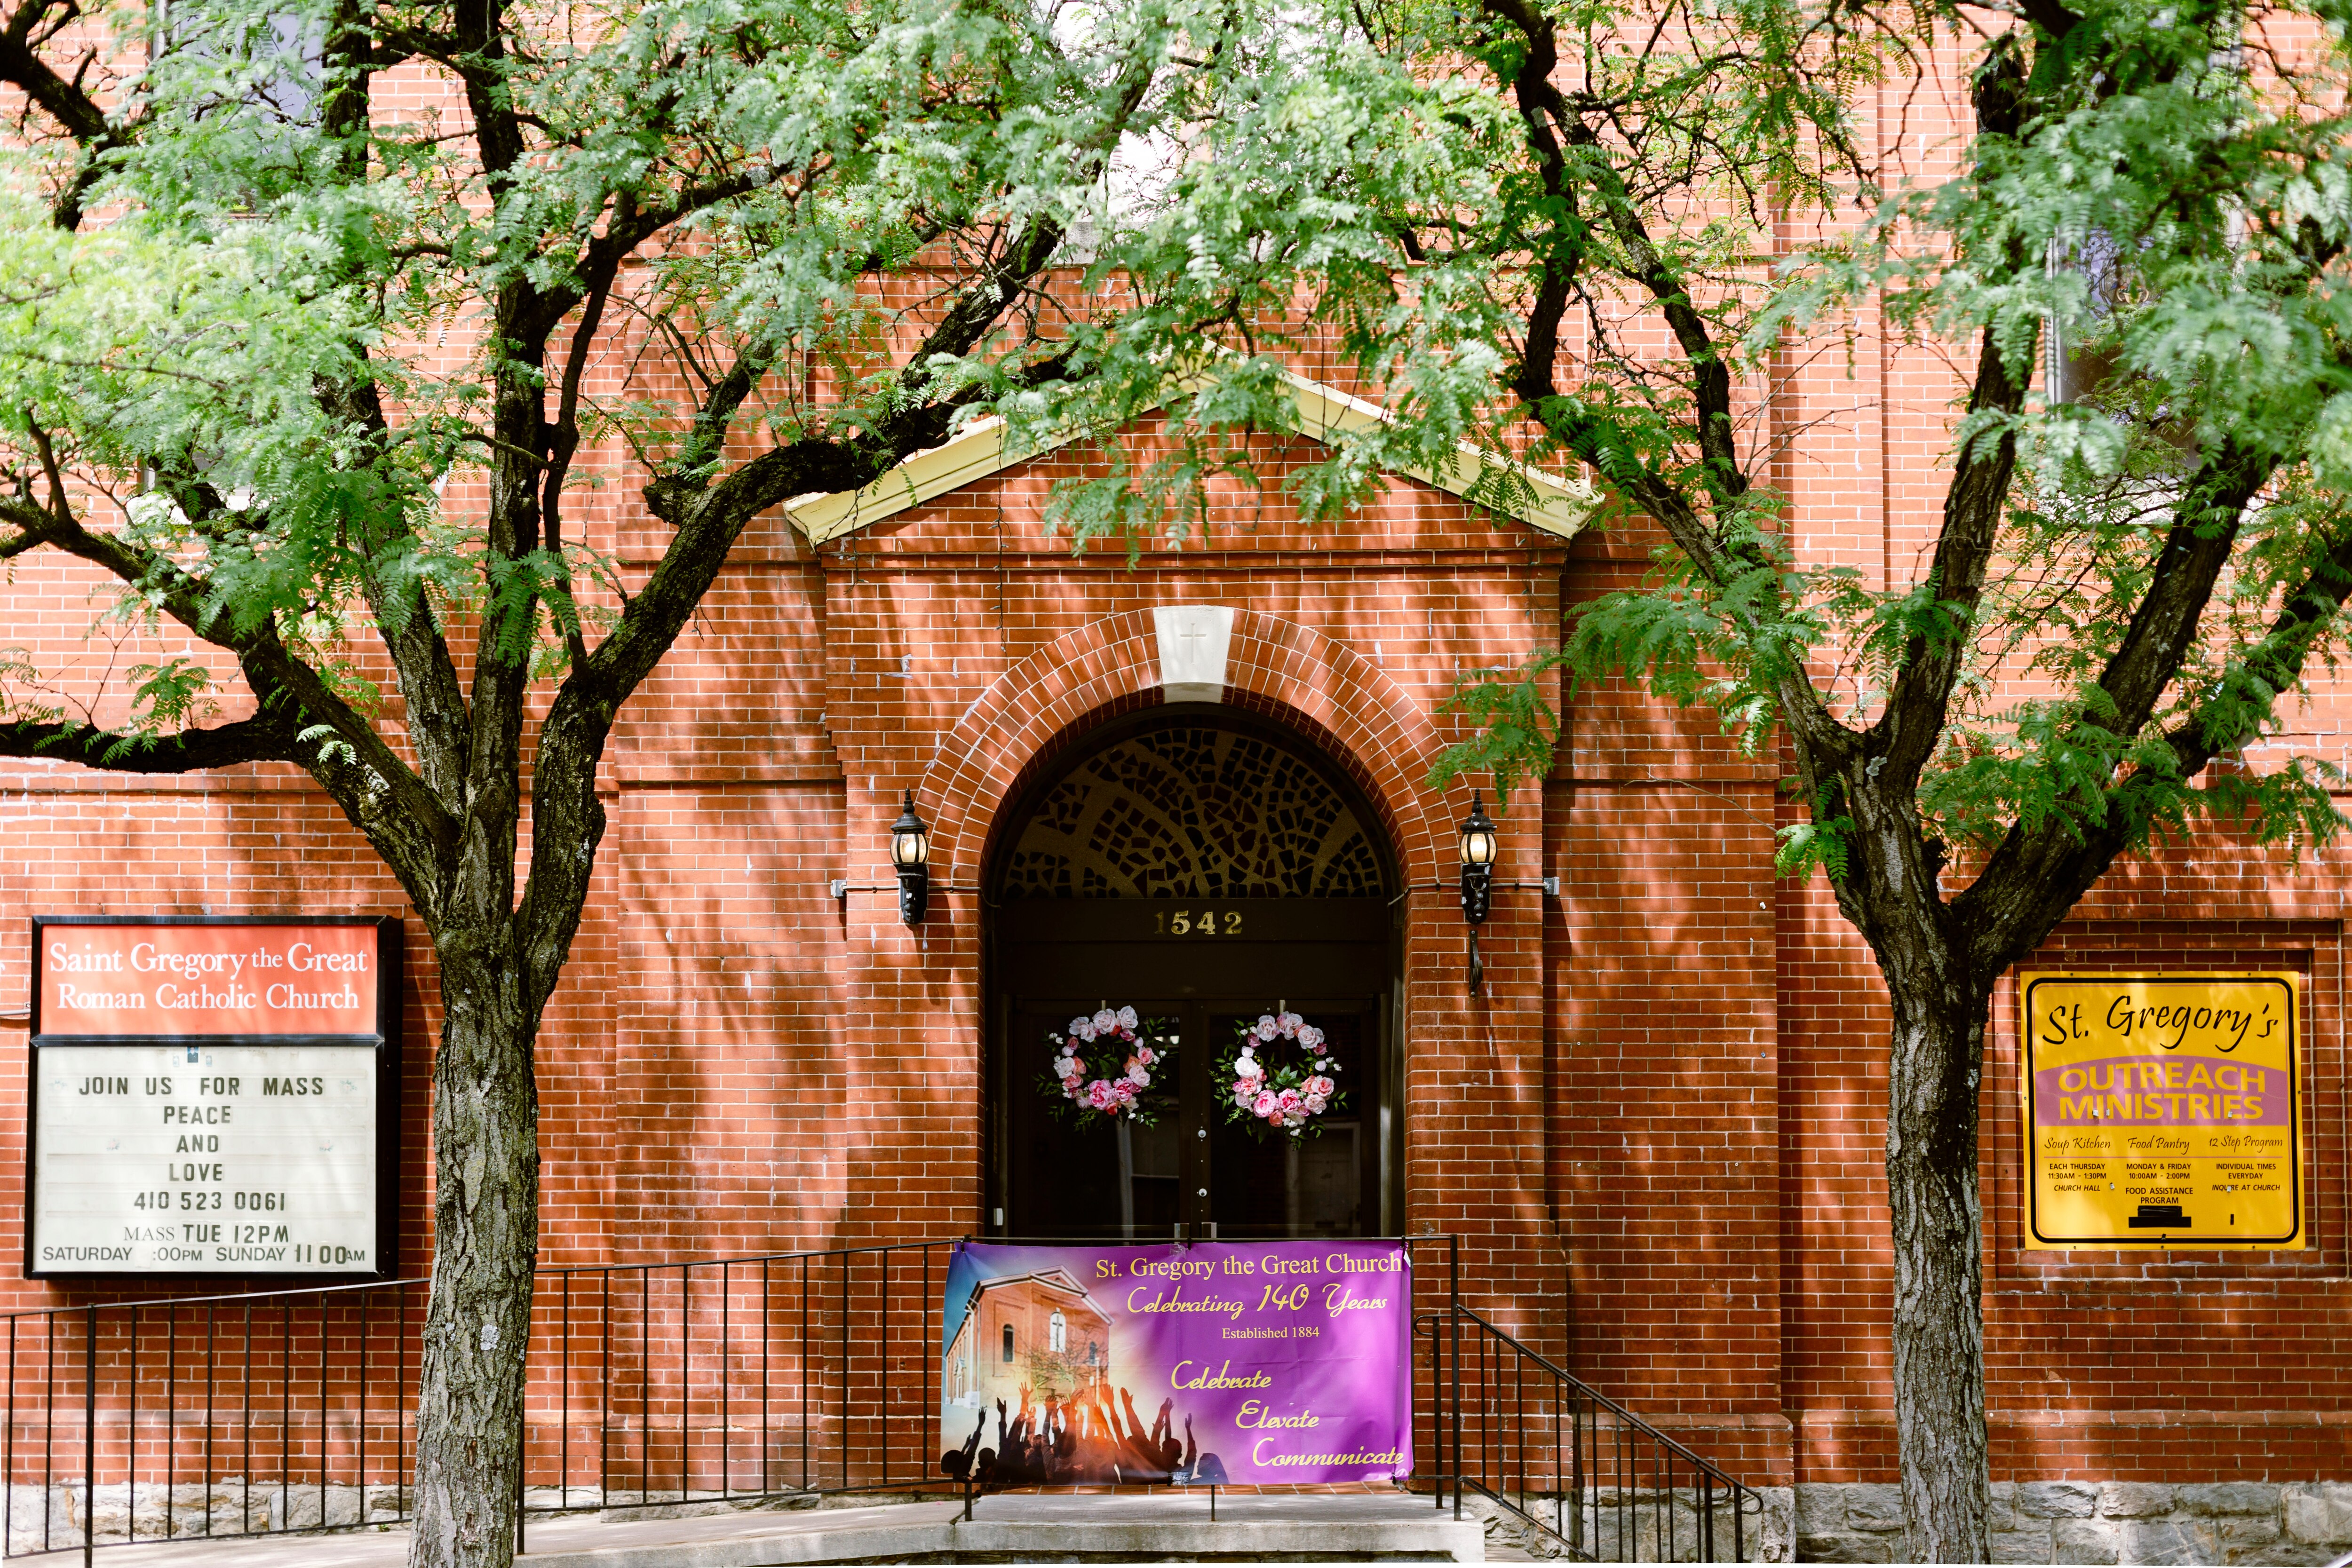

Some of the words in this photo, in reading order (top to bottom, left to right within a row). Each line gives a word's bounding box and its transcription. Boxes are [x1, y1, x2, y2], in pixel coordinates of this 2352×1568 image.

[1154, 910, 1243, 935] 1542
[50, 942, 123, 972] Saint
[130, 942, 247, 980] Gregory
[251, 947, 282, 967] the
[287, 942, 368, 972] Great
[57, 983, 146, 1009] Roman
[155, 983, 256, 1009] Catholic
[266, 983, 359, 1009] Church
[2042, 1004, 2089, 1045] St.
[2106, 995, 2279, 1053] Gregory's
[79, 1077, 128, 1095] JOIN
[146, 1077, 172, 1095] US
[200, 1077, 240, 1096] FOR
[263, 1077, 323, 1096] MASS
[2058, 1062, 2265, 1093] OUTREACH
[164, 1106, 231, 1125] PEACE
[2059, 1093, 2264, 1120] MINISTRIES
[176, 1134, 219, 1153] AND
[2044, 1137, 2069, 1155] Soup
[2073, 1135, 2111, 1149] Kitchen
[2128, 1135, 2156, 1149] Food
[2156, 1137, 2190, 1155] Pantry
[2209, 1138, 2218, 1147] 12
[2221, 1135, 2241, 1153] Step
[2243, 1135, 2283, 1153] Program
[169, 1163, 222, 1181] LOVE
[134, 1191, 169, 1210] 410
[181, 1191, 222, 1210] 523
[234, 1191, 285, 1211] 0061
[123, 1227, 175, 1241] MASS
[183, 1224, 221, 1243] TUE
[234, 1225, 289, 1243] 12PM
[42, 1246, 133, 1261] SATURDAY
[216, 1246, 286, 1261] SUNDAY
[1096, 1259, 1122, 1278] St.
[1130, 1258, 1216, 1281] Gregory
[1222, 1255, 1255, 1275] the
[1261, 1255, 1320, 1275] Great
[1326, 1252, 1402, 1273] Church
[1127, 1285, 1246, 1320] Celebrating
[1256, 1283, 1309, 1311] 140
[1322, 1283, 1388, 1318] Years
[1222, 1327, 1288, 1339] Established
[1292, 1326, 1320, 1338] 1884
[1171, 1359, 1271, 1390] Celebrate
[1235, 1399, 1320, 1429] Elevate
[1252, 1437, 1404, 1466] Communicate
